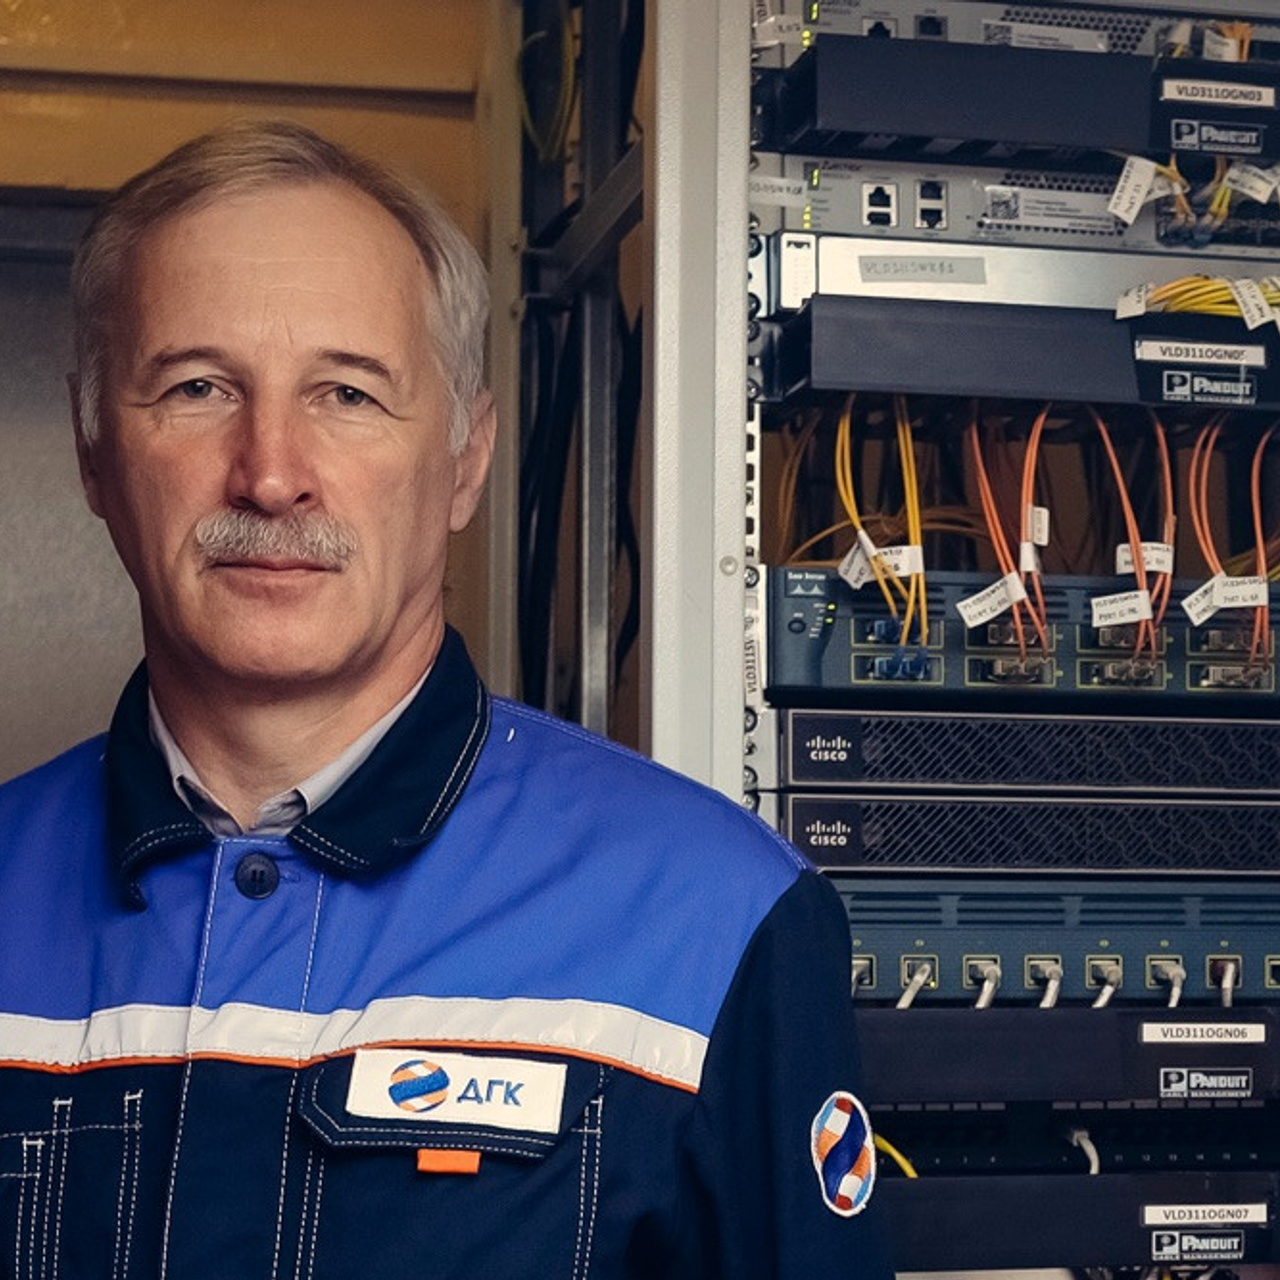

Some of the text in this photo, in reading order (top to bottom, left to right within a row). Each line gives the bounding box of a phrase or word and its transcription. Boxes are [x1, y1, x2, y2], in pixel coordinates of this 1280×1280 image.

[1160, 1027, 1248, 1039] VLD311OGN06
[1189, 1073, 1248, 1089] PANDUIT
[456, 1077, 526, 1108] ДГК
[1163, 1209, 1249, 1220] VLD311OGN07
[1181, 1235, 1240, 1251] PANDUIT
